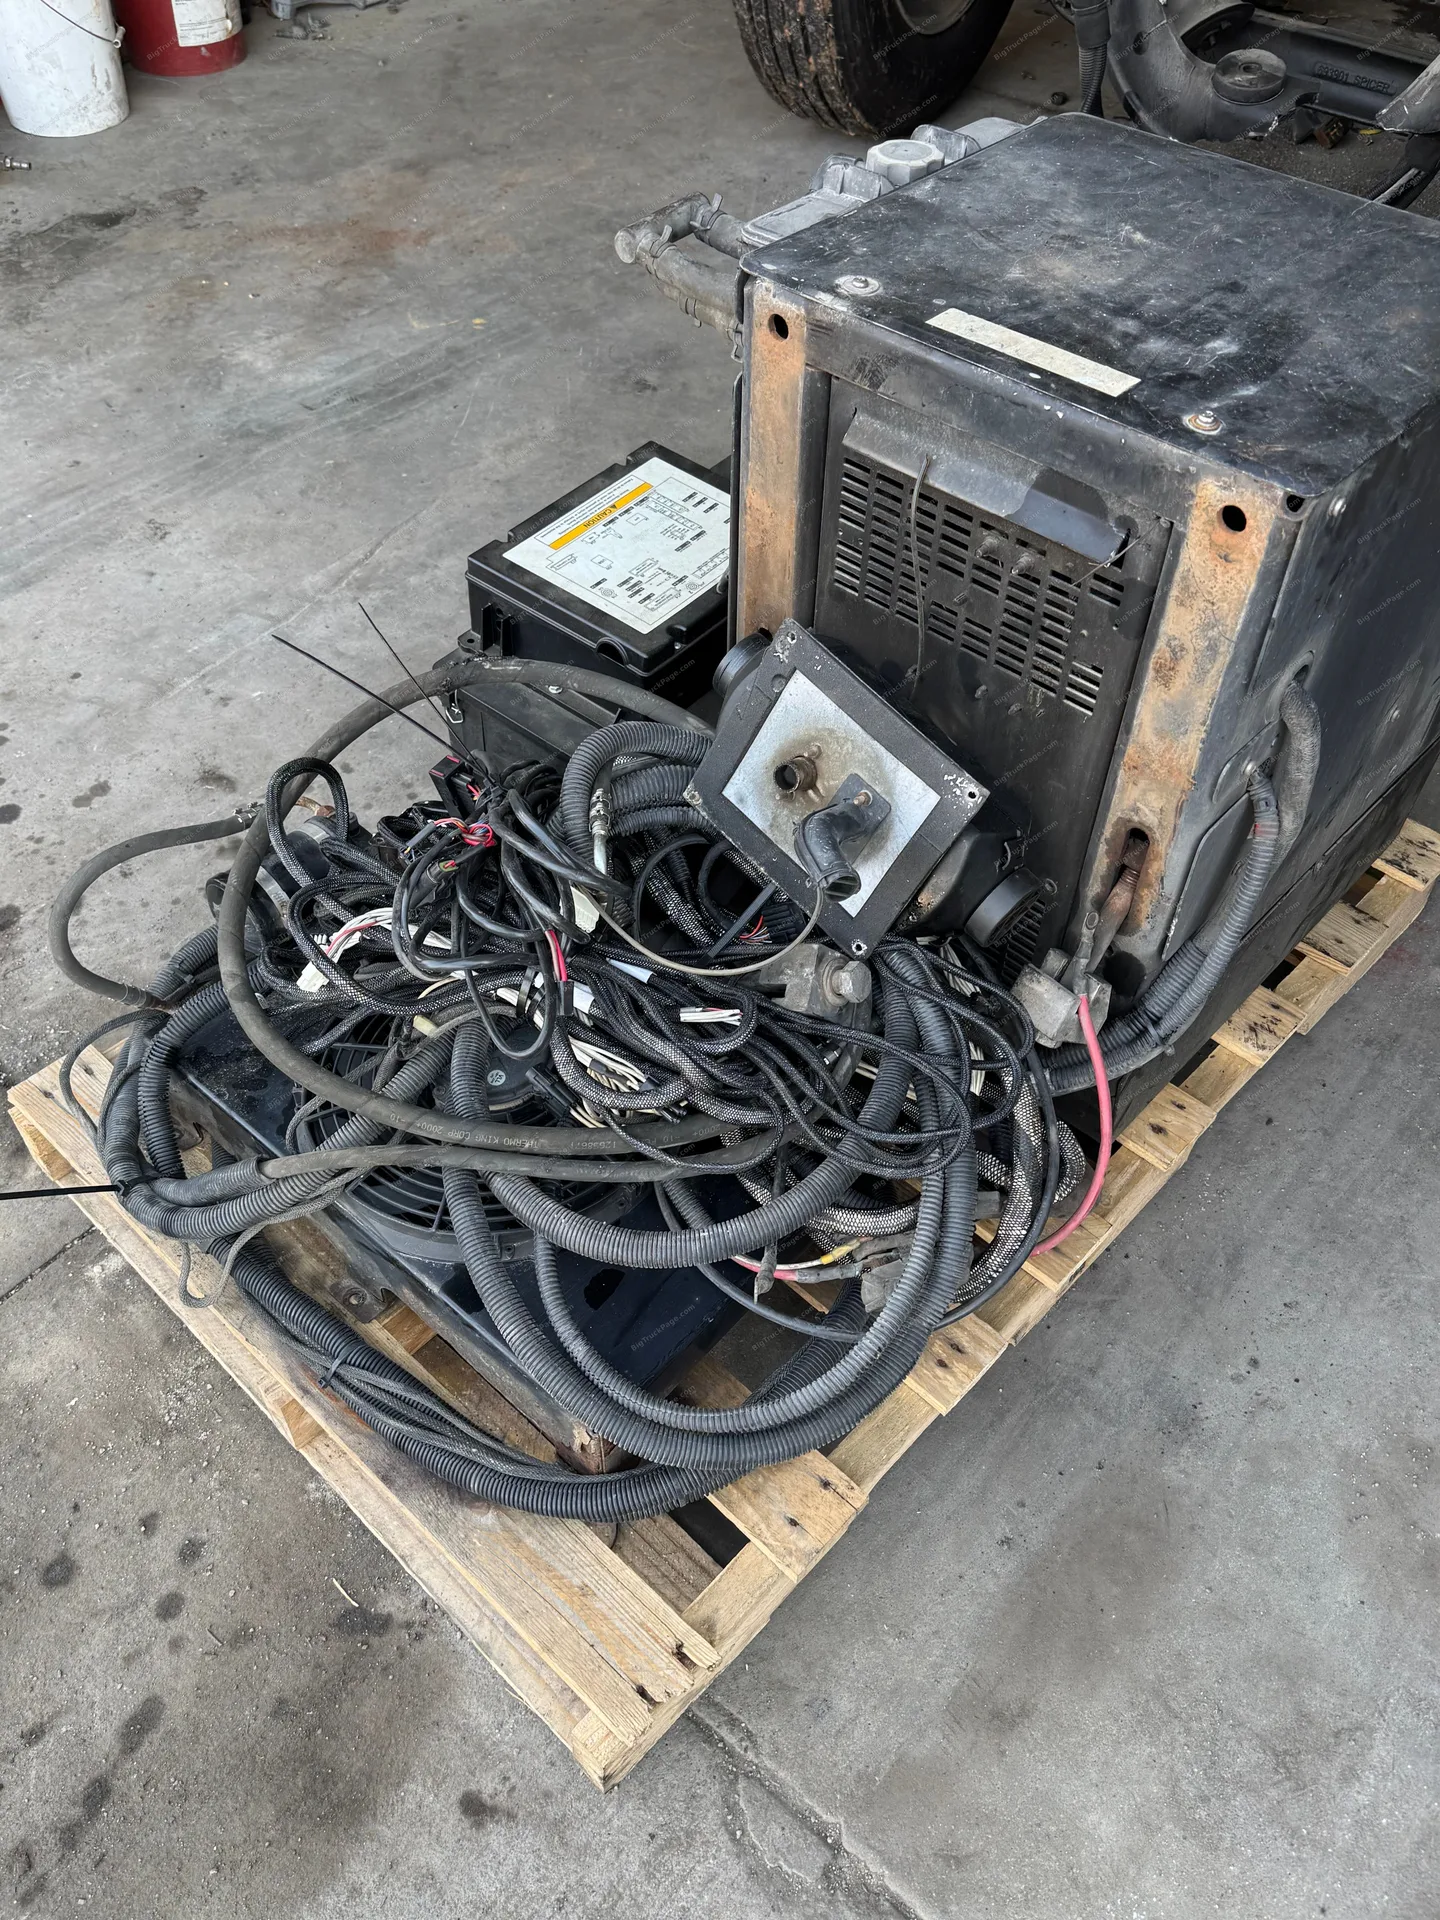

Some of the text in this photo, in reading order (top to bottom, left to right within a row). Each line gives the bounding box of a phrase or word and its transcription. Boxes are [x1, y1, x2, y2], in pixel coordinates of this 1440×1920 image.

[1355, 75, 1391, 93] SPICER
[583, 508, 612, 529] CAUTION
[447, 1128, 471, 1140] CORP
[475, 1134, 499, 1144] KING
[503, 1137, 539, 1149] THERMO
